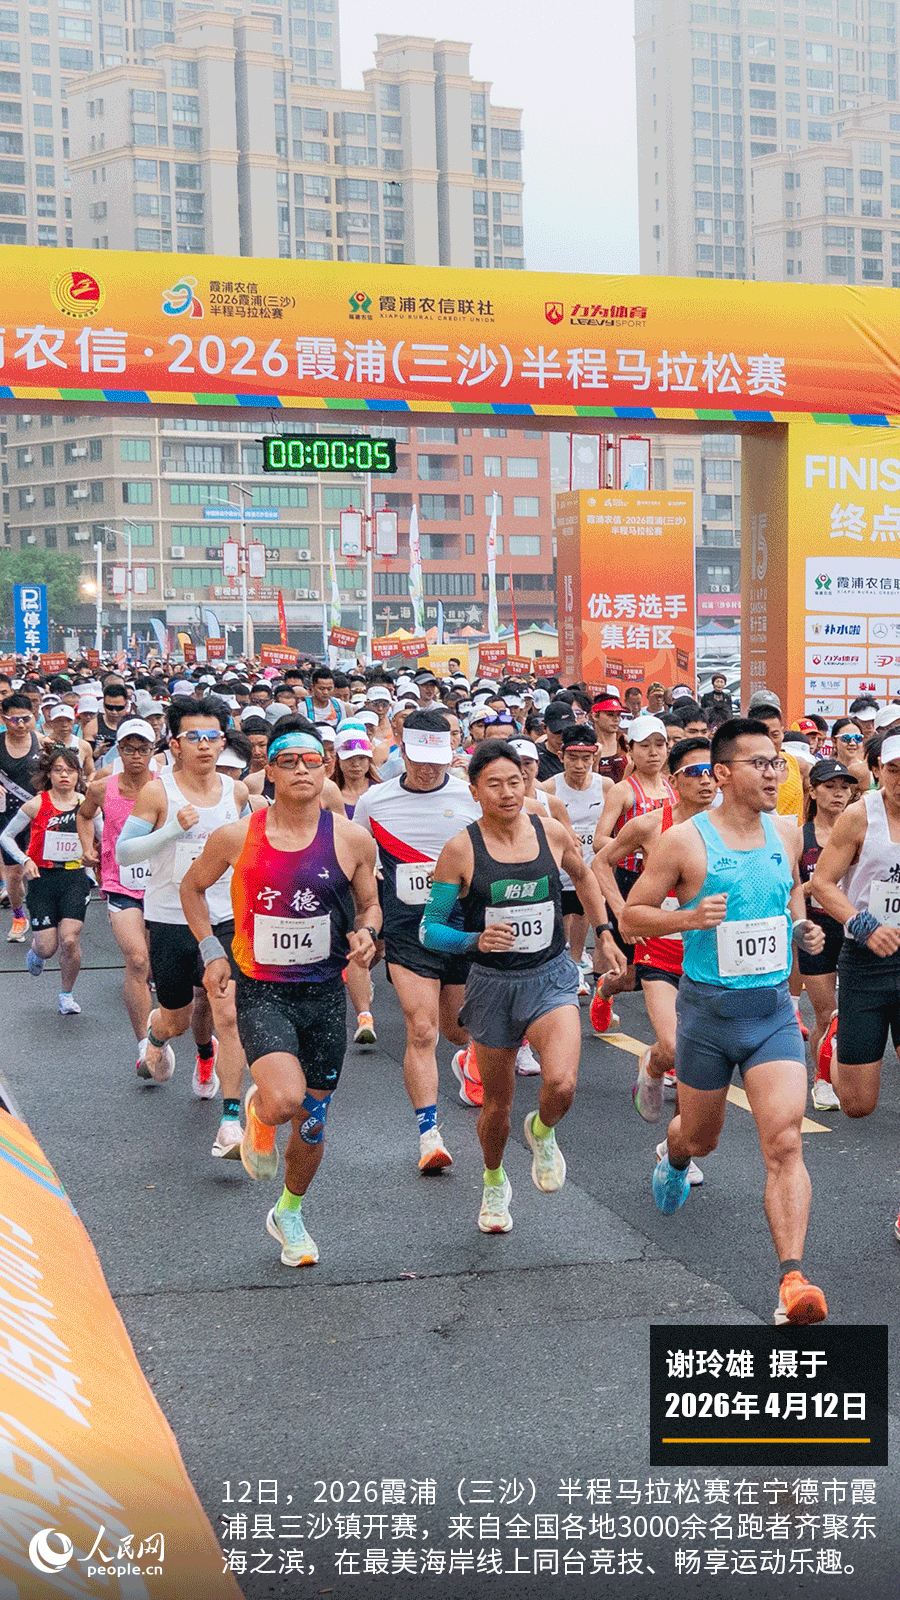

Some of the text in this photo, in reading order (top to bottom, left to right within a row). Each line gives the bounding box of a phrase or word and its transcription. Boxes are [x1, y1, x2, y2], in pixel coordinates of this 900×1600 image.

[209, 280, 258, 294] 霞浦农信
[209, 293, 296, 308] 2026霞浦(三沙)
[379, 295, 494, 316] 霞浦农信联社
[570, 303, 648, 319] 力为体育
[210, 305, 284, 319] 半程马拉松赛
[0, 324, 787, 397] 农信·2026霞浦(三沙)半程马拉松赛
[269, 440, 391, 469] 00:00:05
[805, 454, 900, 492] FINIS
[829, 502, 900, 543] 终点
[587, 593, 688, 619] 优秀选手
[601, 624, 676, 650] 集结区
[825, 624, 861, 635] 补水啦
[56, 841, 78, 852] 1102
[257, 886, 321, 912] 宁德
[504, 881, 538, 899] 怡寶
[271, 932, 313, 950] 1014
[736, 935, 777, 957] 1073
